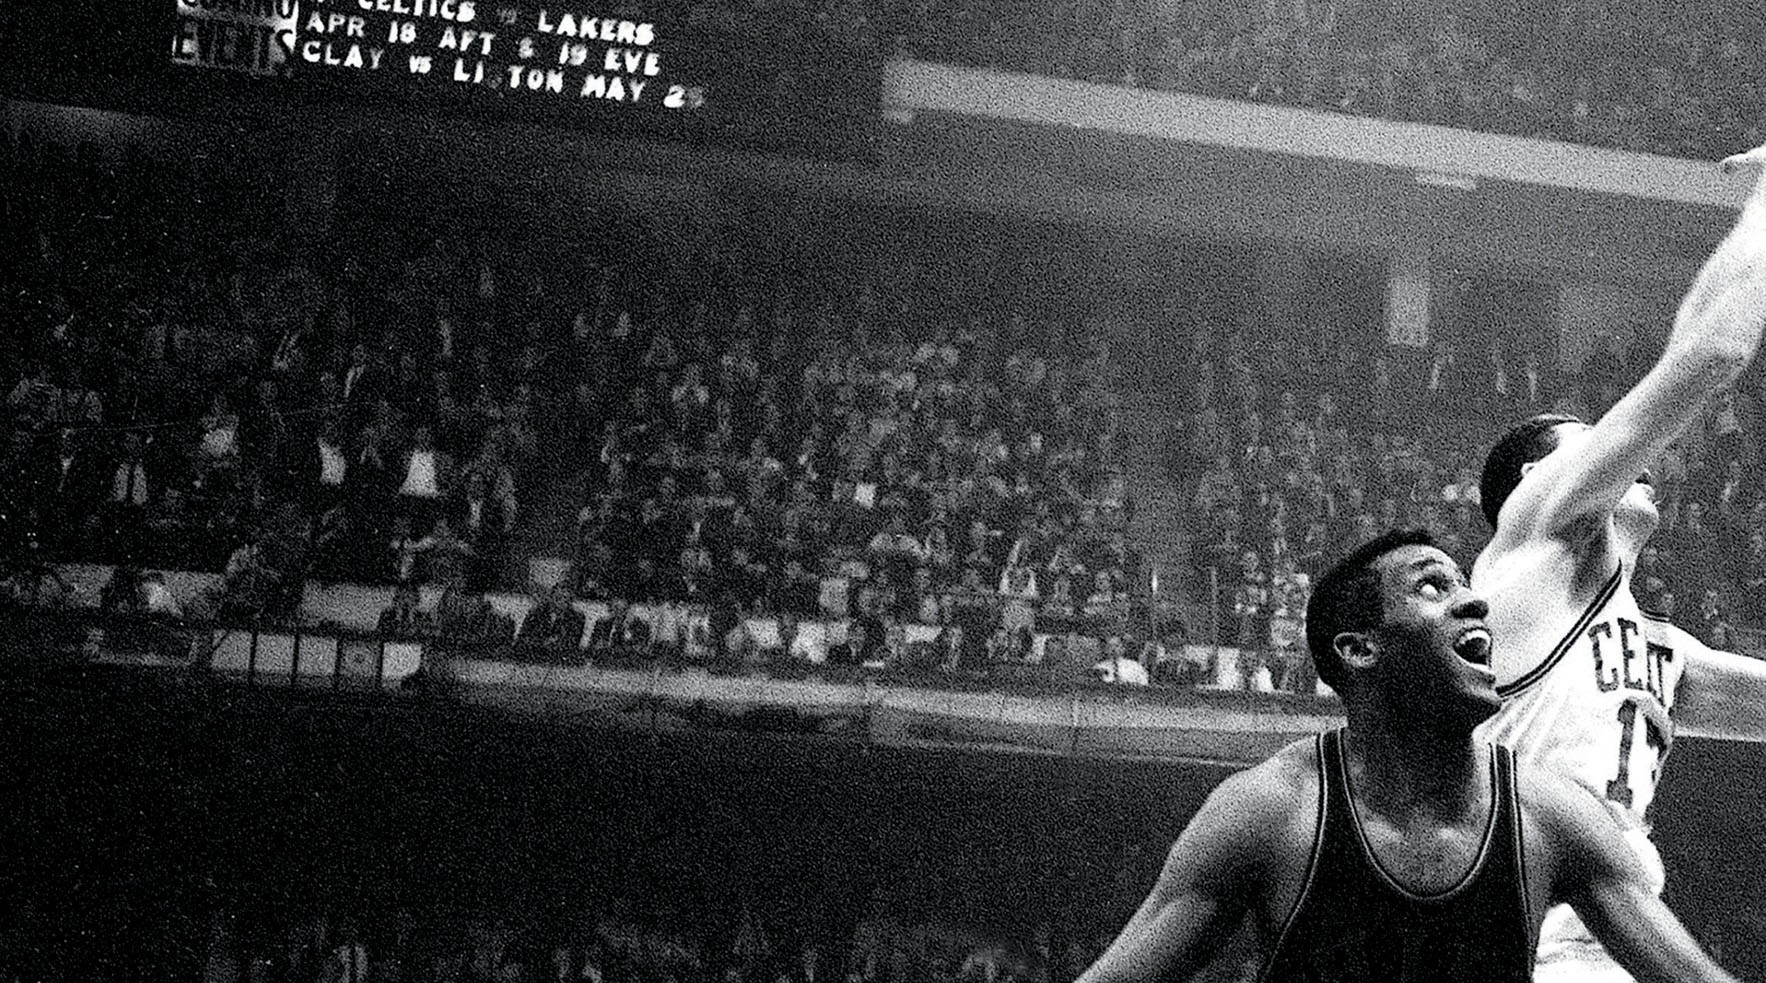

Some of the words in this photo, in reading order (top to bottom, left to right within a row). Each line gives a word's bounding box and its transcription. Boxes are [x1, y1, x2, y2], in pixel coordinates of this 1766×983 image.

[305, 11, 366, 38] APR
[388, 20, 416, 44] 18
[604, 49, 660, 77] EVE
[537, 10, 655, 46] LAKERS
[302, 41, 383, 70] CLAY
[453, 57, 564, 94] LITON
[580, 73, 646, 102] MAY
